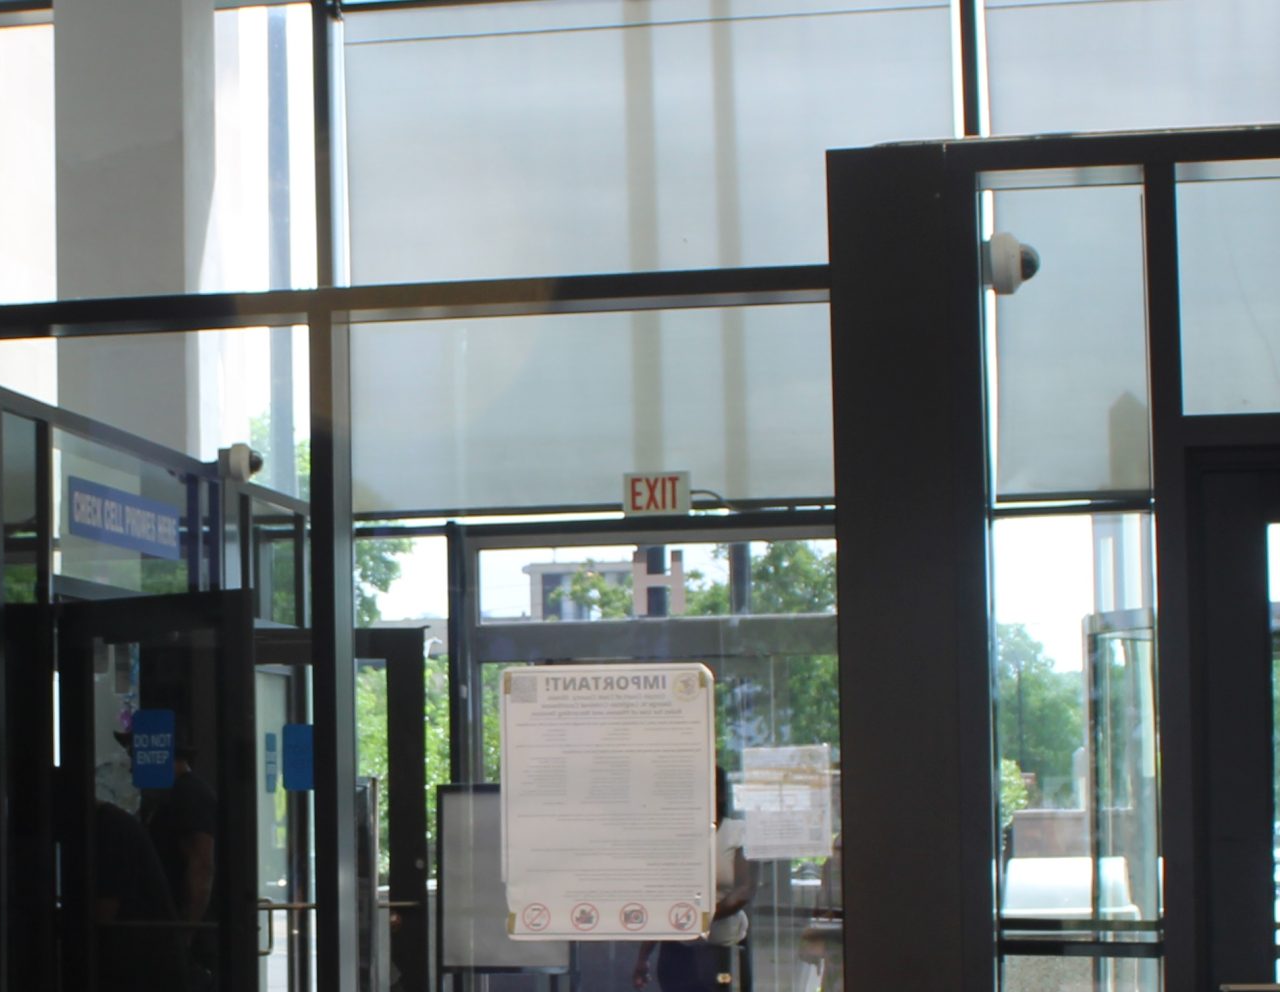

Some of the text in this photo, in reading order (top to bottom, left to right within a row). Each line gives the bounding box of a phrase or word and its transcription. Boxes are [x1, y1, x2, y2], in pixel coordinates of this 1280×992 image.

[631, 476, 679, 511] EXIT
[73, 490, 103, 528] CHECK
[104, 499, 124, 533] CELL
[134, 733, 172, 748] DO NOT
